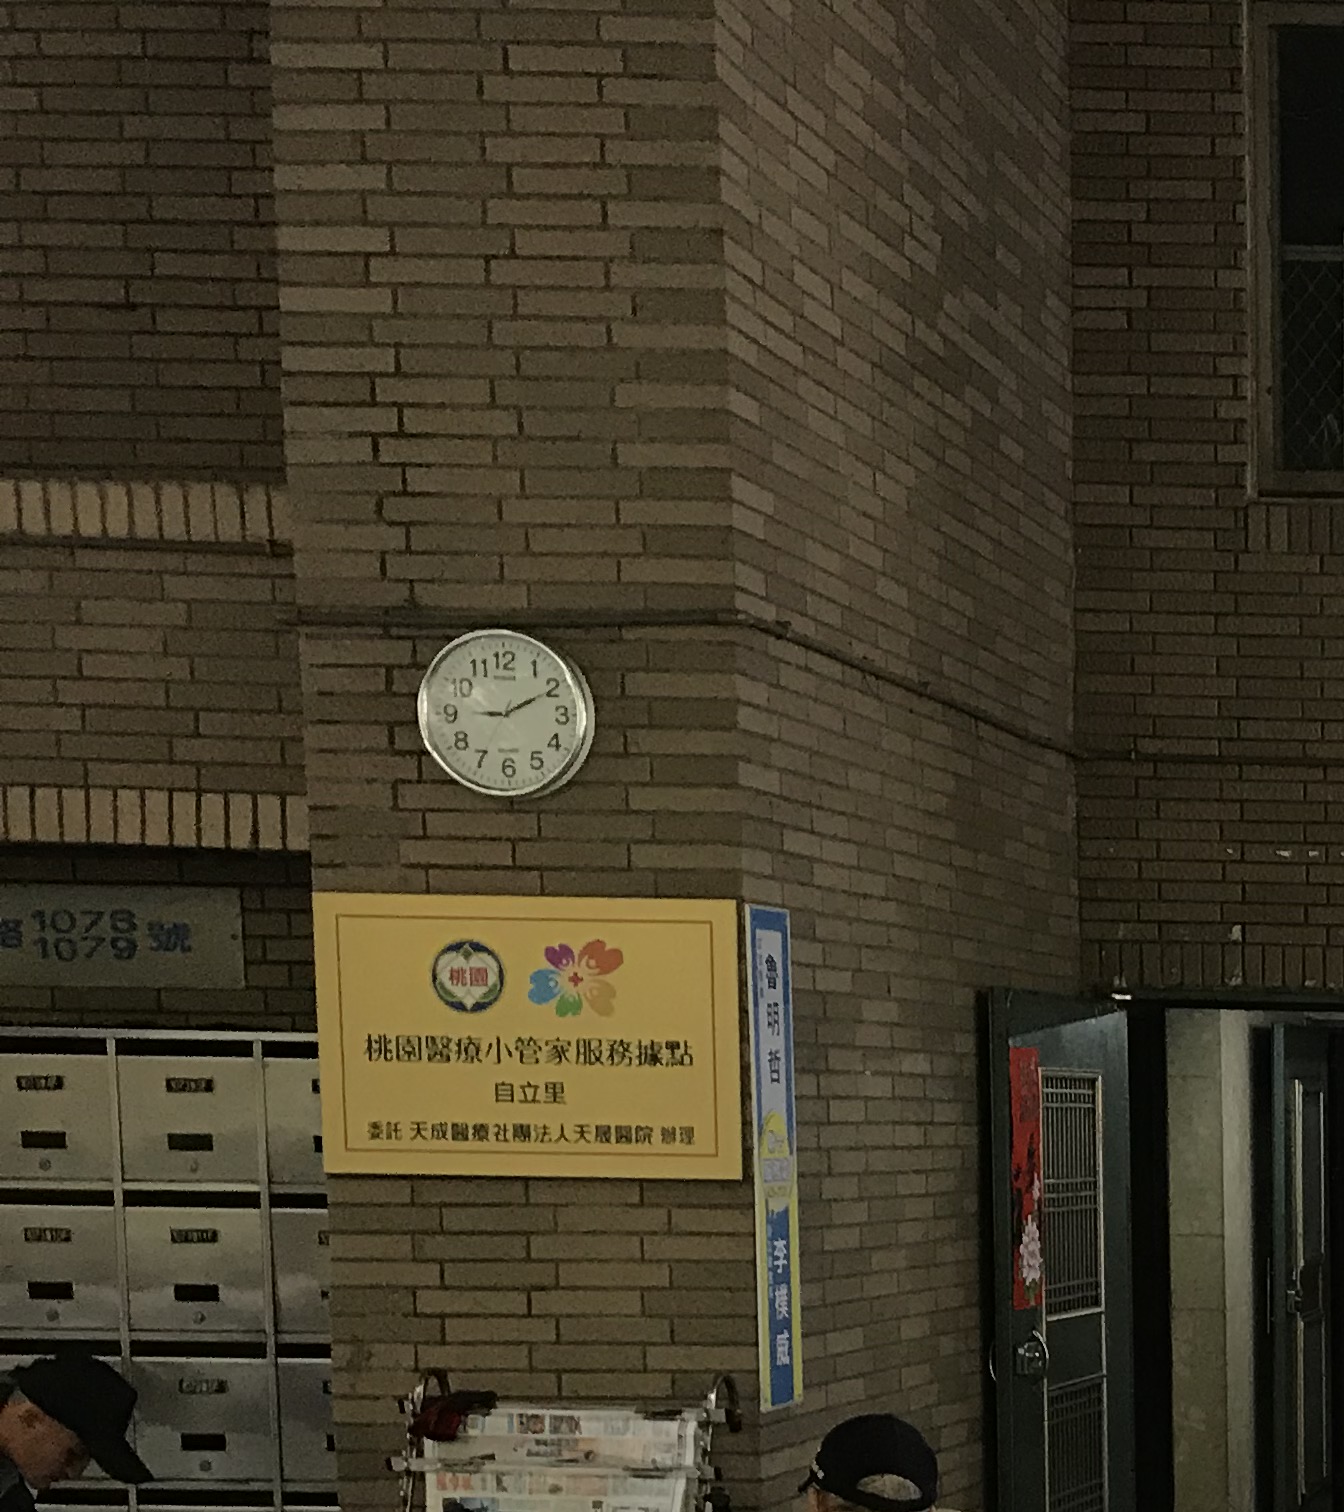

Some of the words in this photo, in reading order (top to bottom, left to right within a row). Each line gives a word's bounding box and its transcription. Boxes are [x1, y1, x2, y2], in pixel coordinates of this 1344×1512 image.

[470, 658, 488, 678] 11
[492, 650, 516, 671] 12
[530, 658, 538, 678] 1
[452, 677, 473, 698] 10
[545, 677, 560, 698] 2
[443, 703, 458, 724] 9
[555, 705, 570, 725] 3
[454, 730, 470, 751] 8
[546, 732, 561, 751] 4
[474, 749, 488, 769] 7
[501, 757, 516, 778] 6
[529, 750, 544, 770] 5
[447, 966, 489, 988] 桃園
[364, 1032, 694, 1068] 桃園醫療小管家服務據點
[493, 1081, 567, 1105] 自立里
[367, 1121, 402, 1142] 委託
[660, 1126, 696, 1146] 辦理
